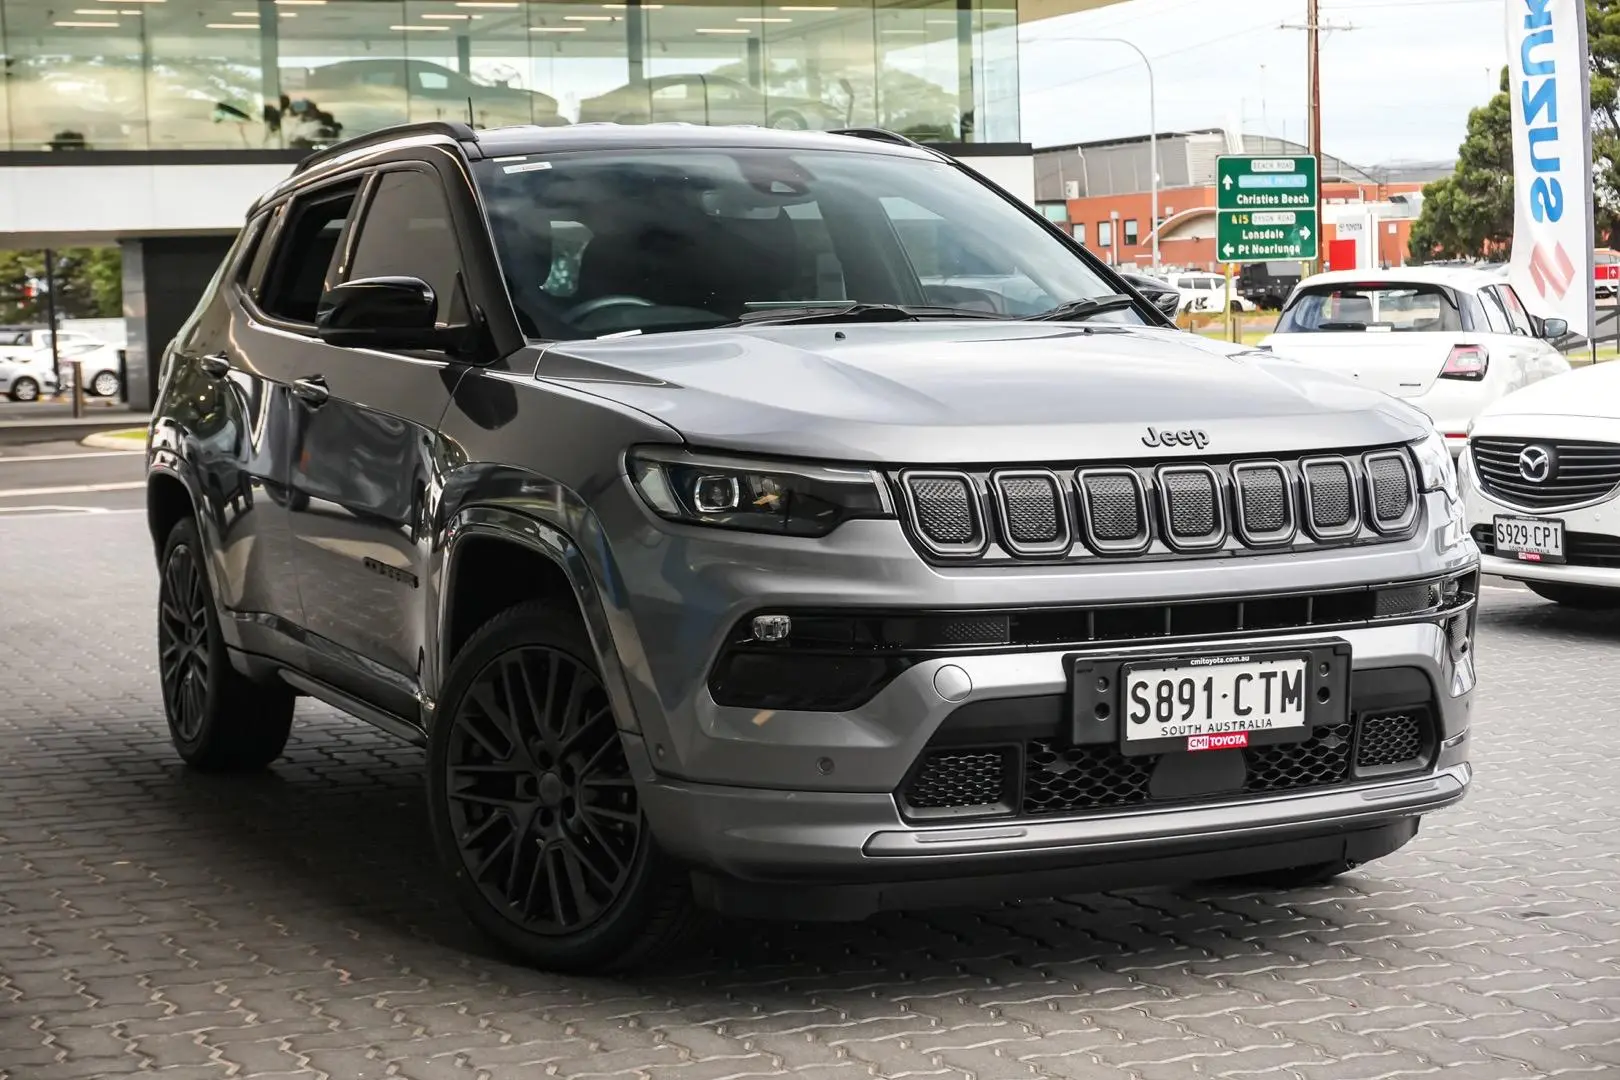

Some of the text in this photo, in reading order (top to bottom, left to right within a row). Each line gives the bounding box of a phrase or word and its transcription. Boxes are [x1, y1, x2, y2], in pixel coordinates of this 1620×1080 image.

[1276, 161, 1294, 169] ROAD
[1236, 193, 1309, 205] Christies Beach
[1231, 214, 1249, 225] A15
[1277, 213, 1295, 222] ROAD
[1242, 229, 1285, 240] Lonsdale
[1238, 243, 1301, 256] Pt Noarlunga
[1141, 426, 1210, 450] Jeep
[1190, 655, 1250, 666] cmitoyota.com.au
[1161, 718, 1273, 737] SOUTH AUSTRALIA
[1209, 734, 1247, 747] TOYOTA
